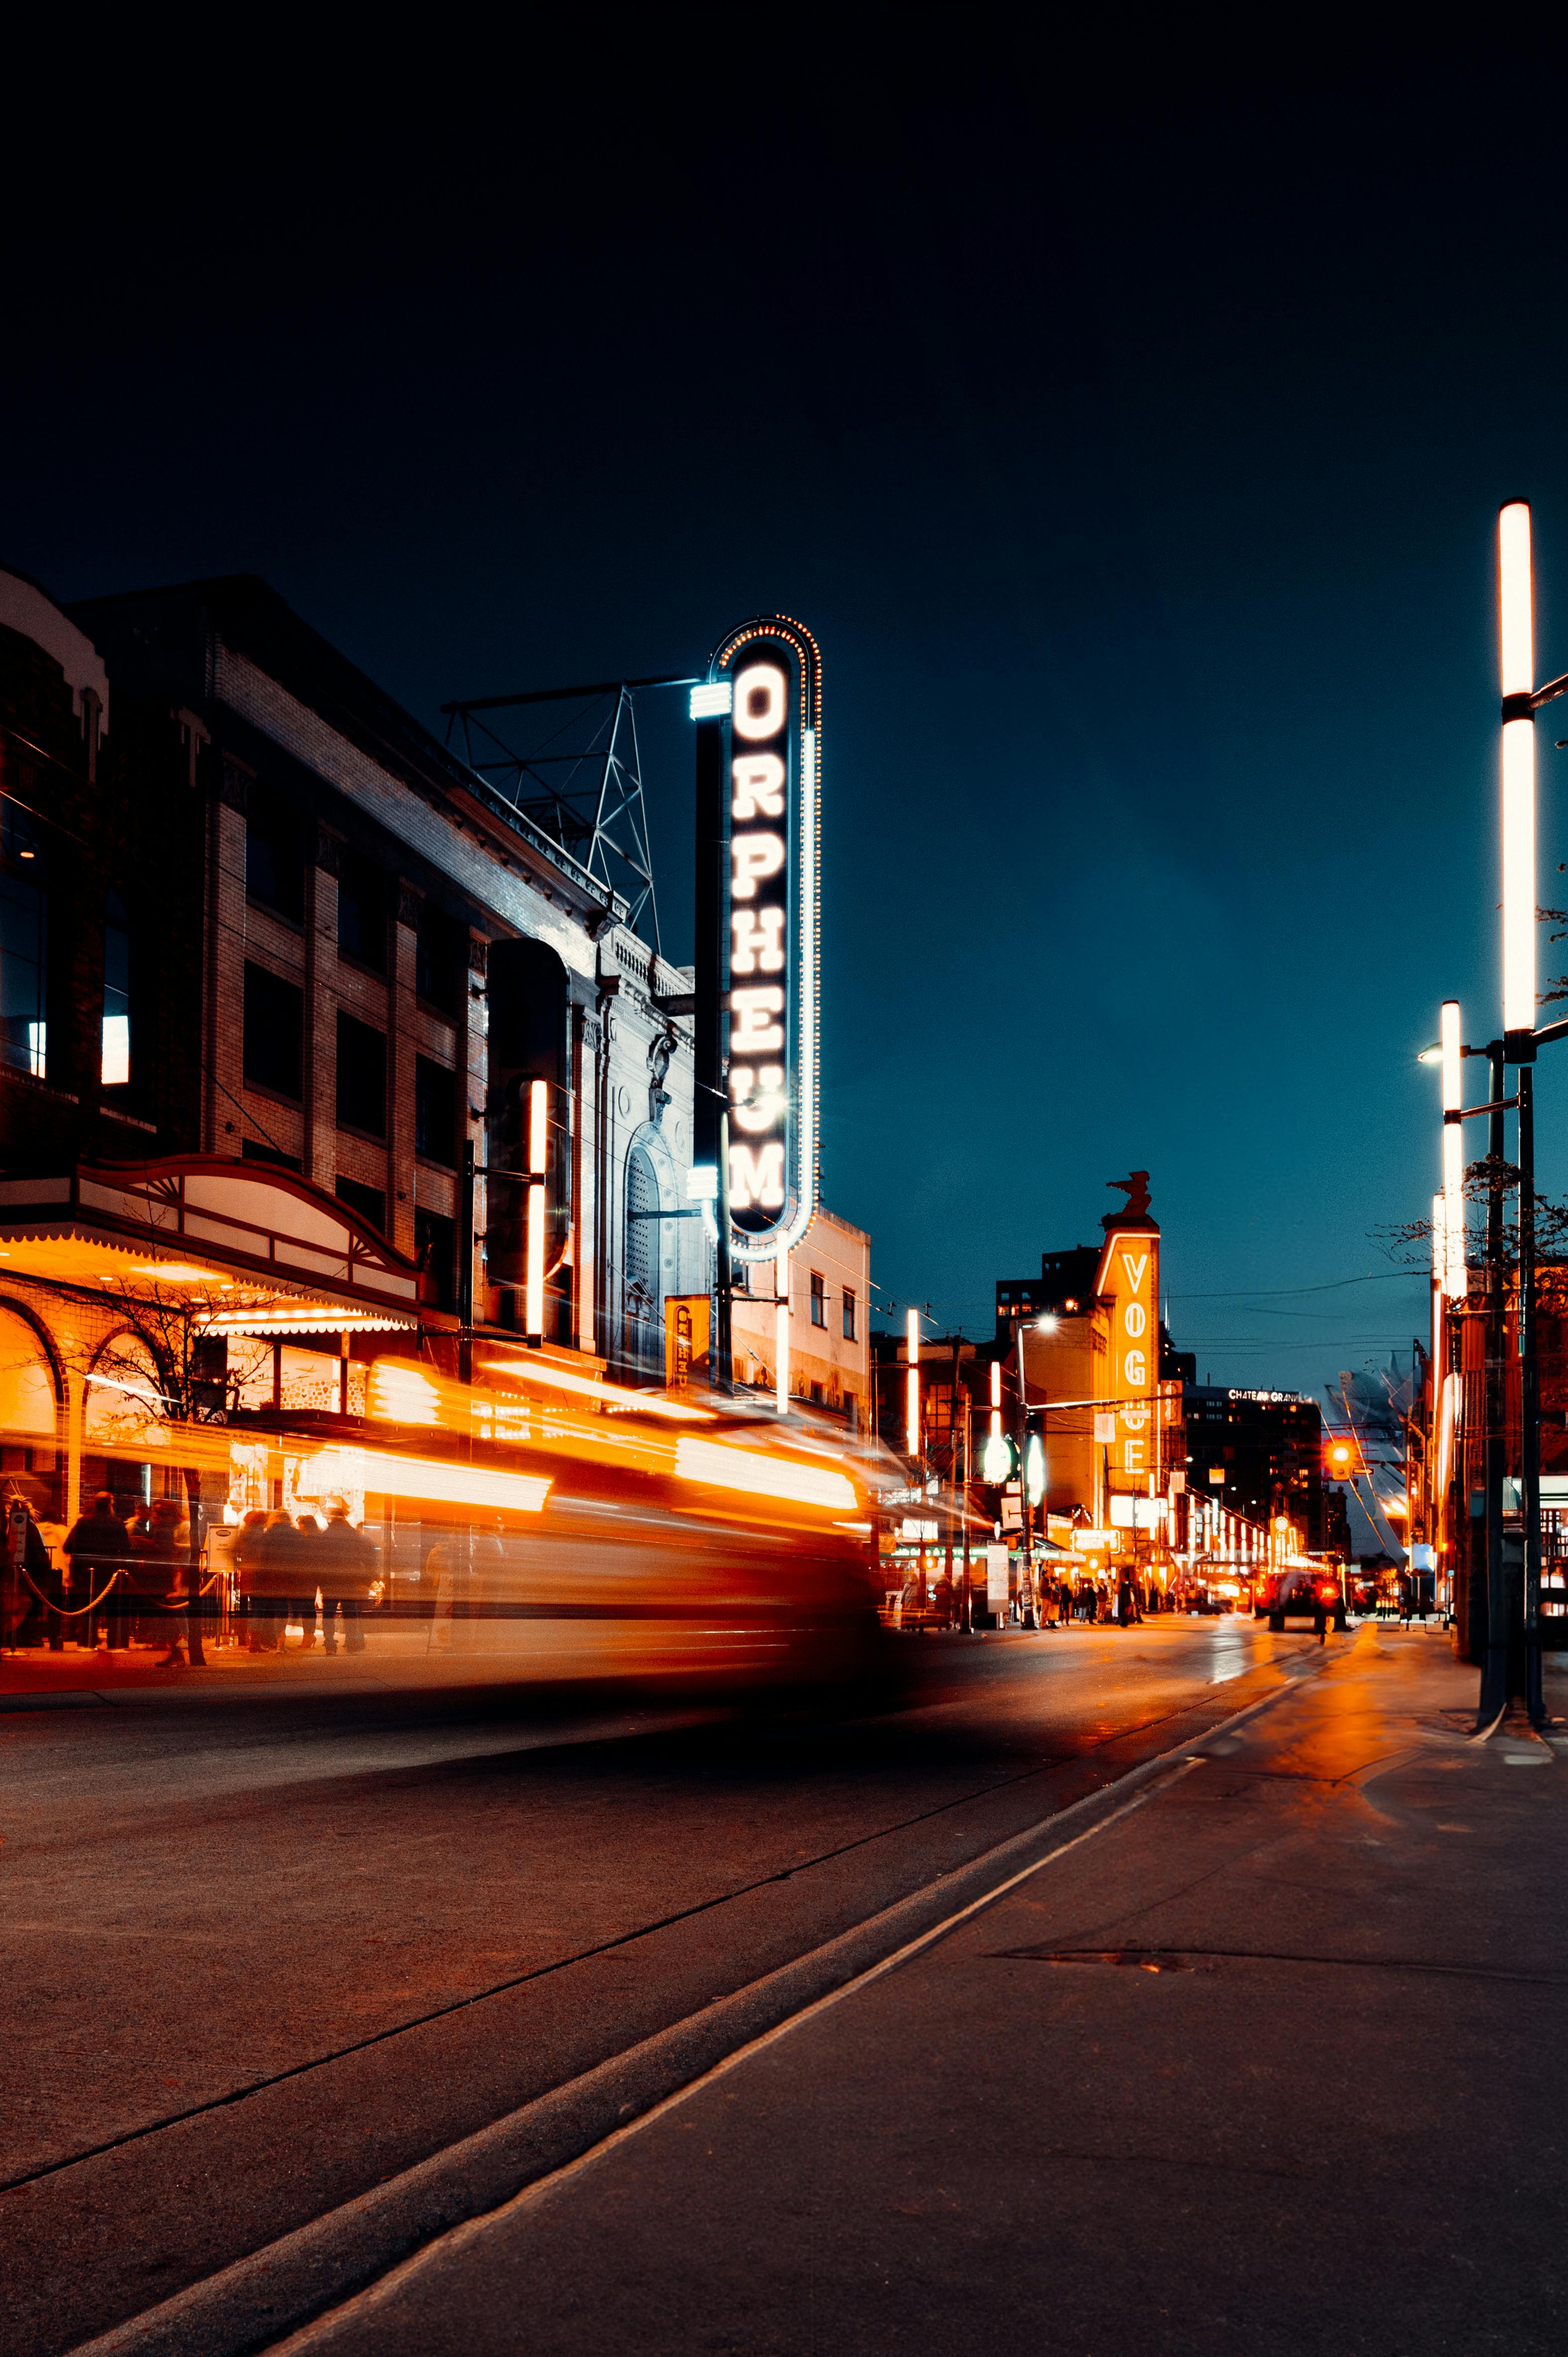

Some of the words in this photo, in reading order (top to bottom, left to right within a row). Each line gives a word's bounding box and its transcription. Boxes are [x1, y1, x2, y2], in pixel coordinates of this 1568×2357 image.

[730, 664, 785, 1208] ORPHEUM
[1122, 1254, 1148, 1474] VOGUE
[1228, 1388, 1269, 1401] CHATEAU
